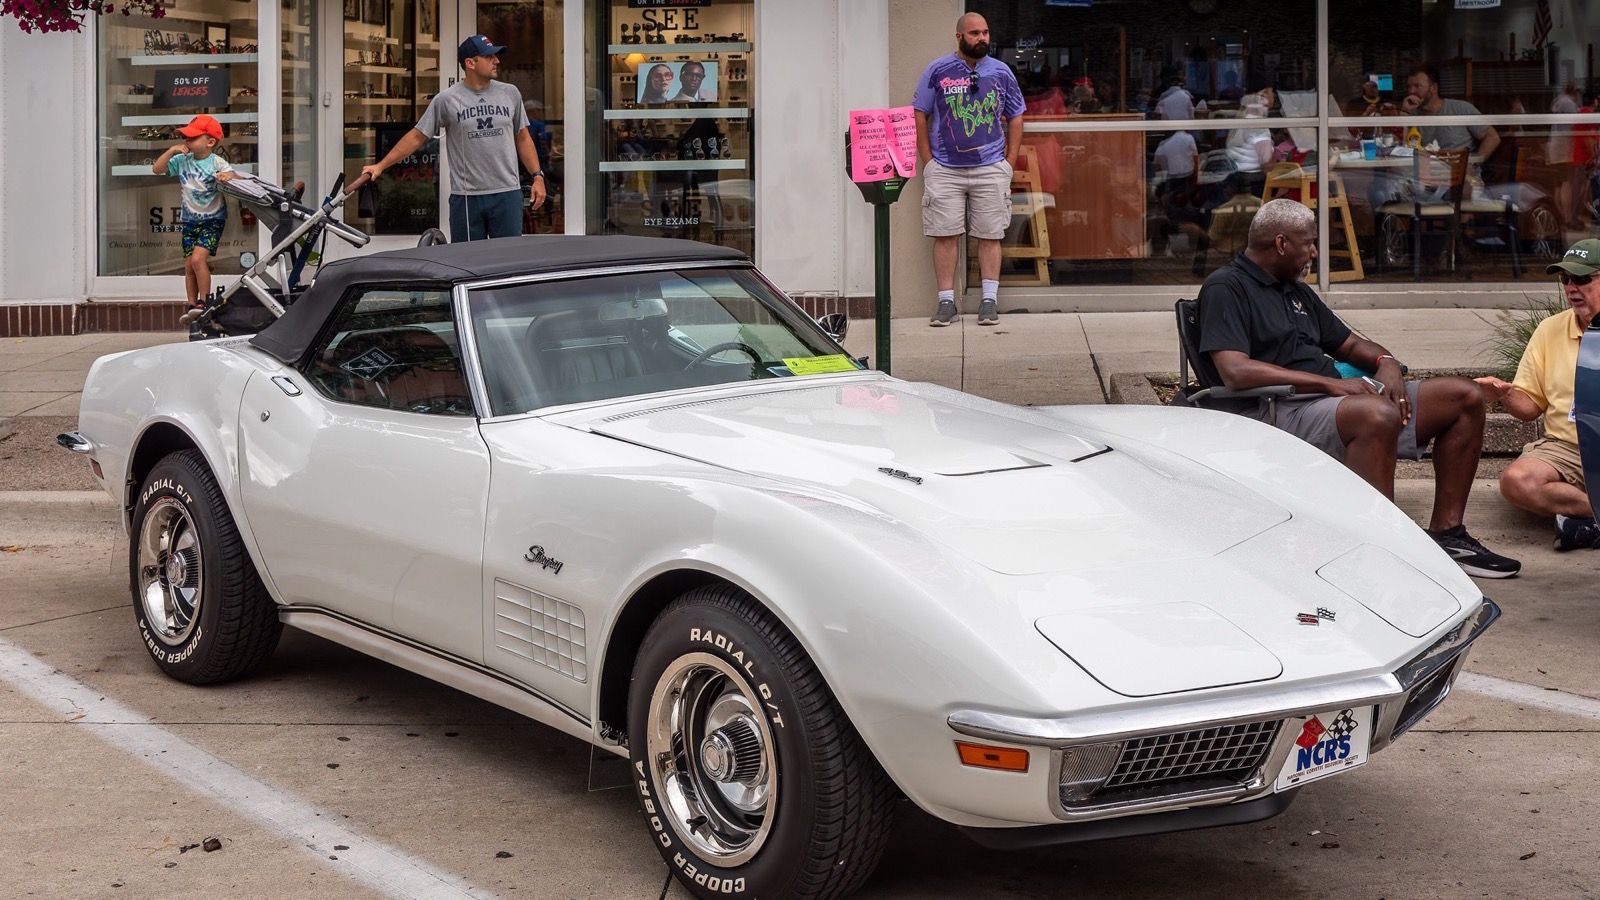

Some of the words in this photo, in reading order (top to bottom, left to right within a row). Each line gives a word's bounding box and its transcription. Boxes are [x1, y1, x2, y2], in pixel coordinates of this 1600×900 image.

[642, 8, 699, 31] SEE
[193, 77, 210, 85] OFF
[944, 86, 968, 94] LIGHT
[172, 86, 209, 97] LENSES
[457, 105, 510, 123] MICHIGAN
[476, 117, 494, 130] M
[397, 154, 418, 164] 0%
[154, 225, 171, 233] EYE
[644, 218, 662, 226] EYE
[666, 217, 699, 225] EXAMS
[109, 240, 137, 249] Chicago
[139, 240, 163, 248] Detroit
[142, 478, 174, 505] RADIAL
[139, 618, 165, 661] COBRA
[167, 626, 203, 664] COOPER
[690, 628, 755, 678] RADIAL
[758, 683, 785, 728] G/T
[1296, 735, 1351, 772] NCRS
[635, 760, 672, 848] COBRA
[673, 851, 746, 894] COOPER
